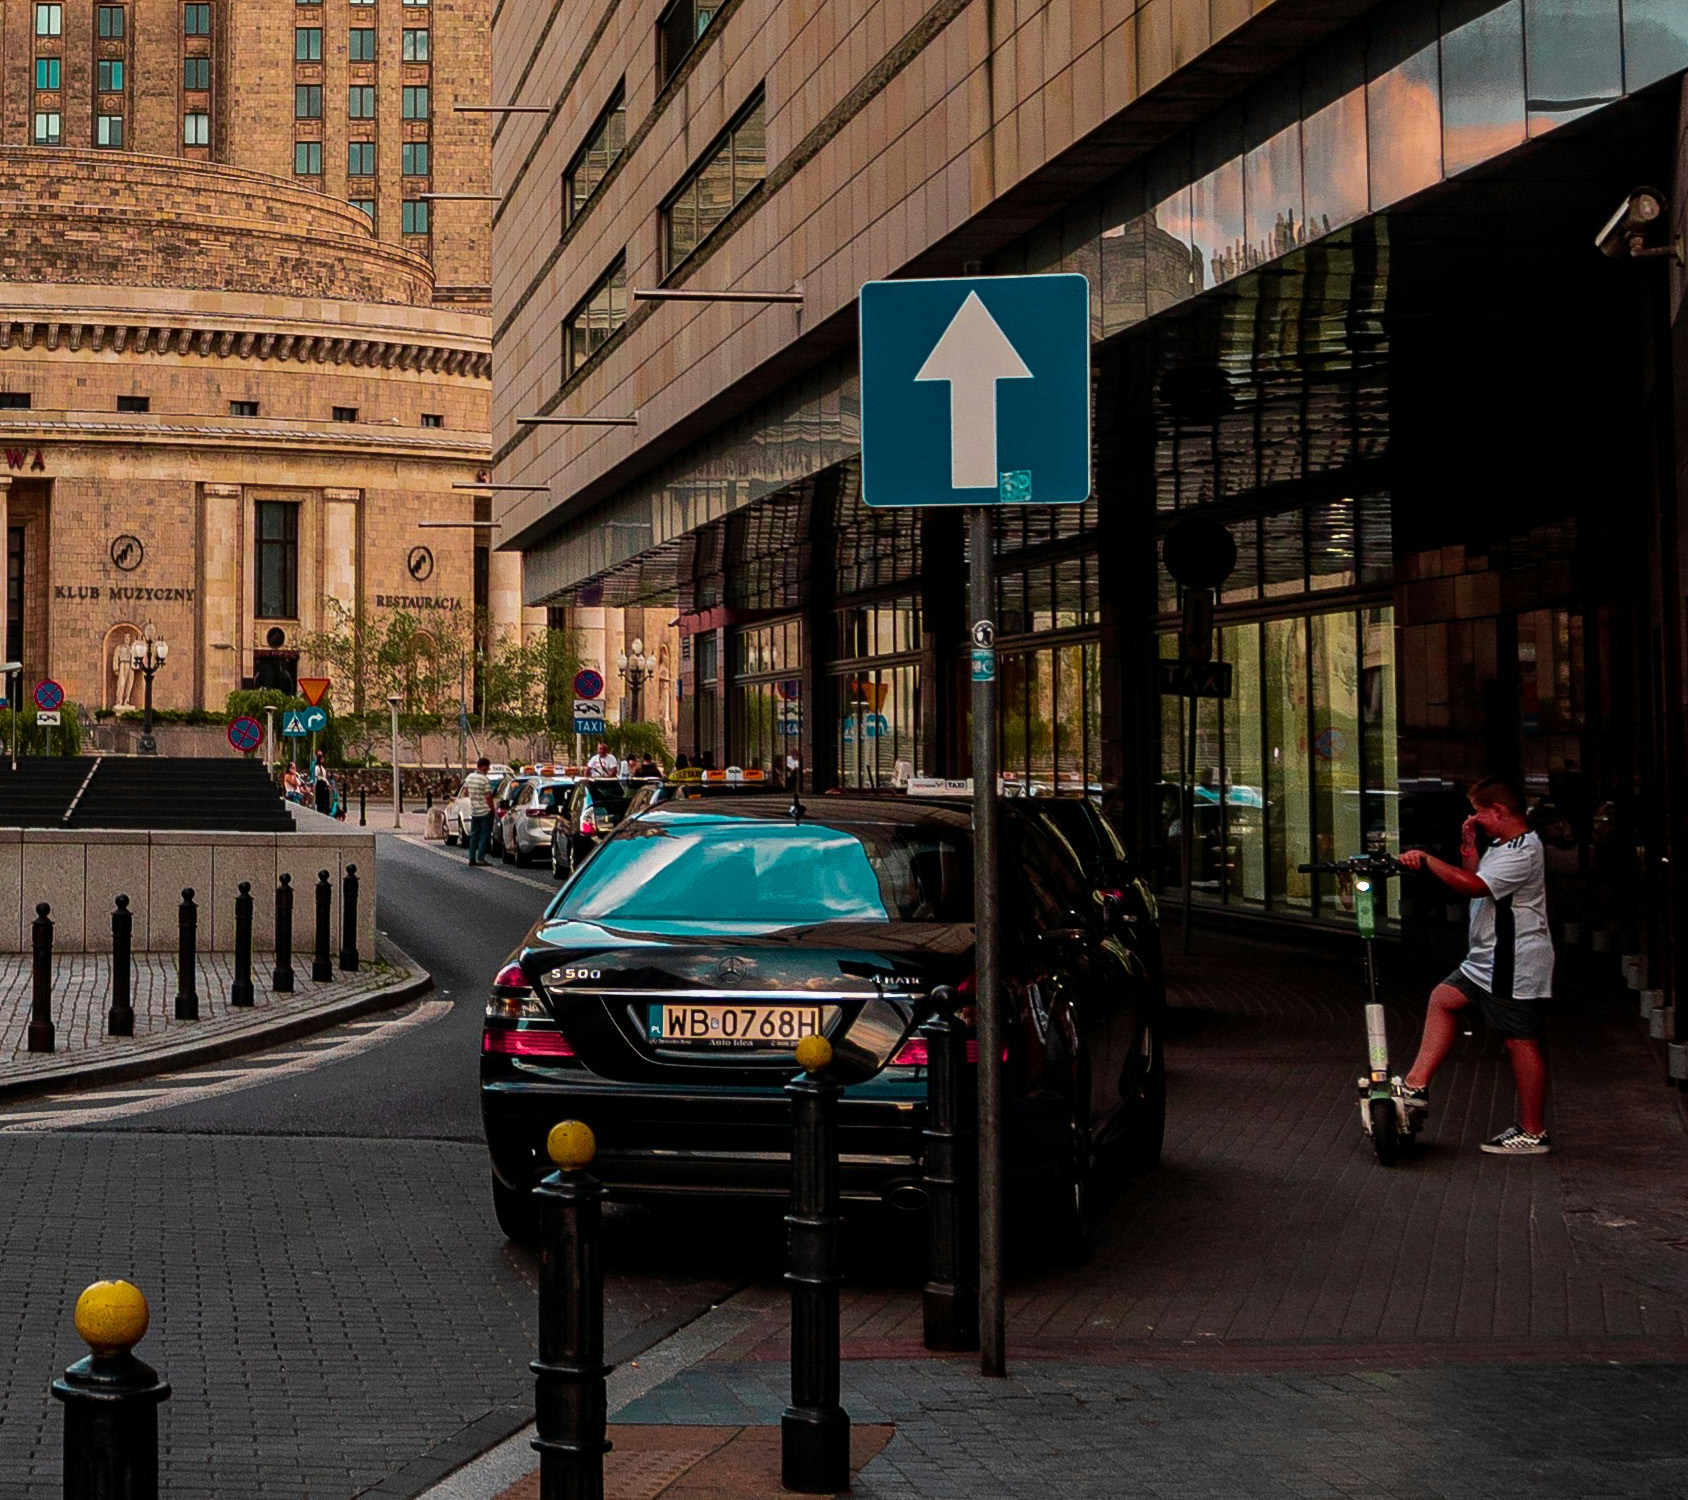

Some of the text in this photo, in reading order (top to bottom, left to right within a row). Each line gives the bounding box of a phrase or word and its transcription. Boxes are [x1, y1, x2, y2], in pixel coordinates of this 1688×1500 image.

[54, 586, 195, 601] KLUB MUZYCZNY
[376, 594, 463, 611] RESTAURACJA
[577, 720, 602, 732] TAXI
[551, 968, 601, 979] S 500
[668, 1008, 816, 1039] WB 0768H
[733, 1039, 754, 1047] Idea
